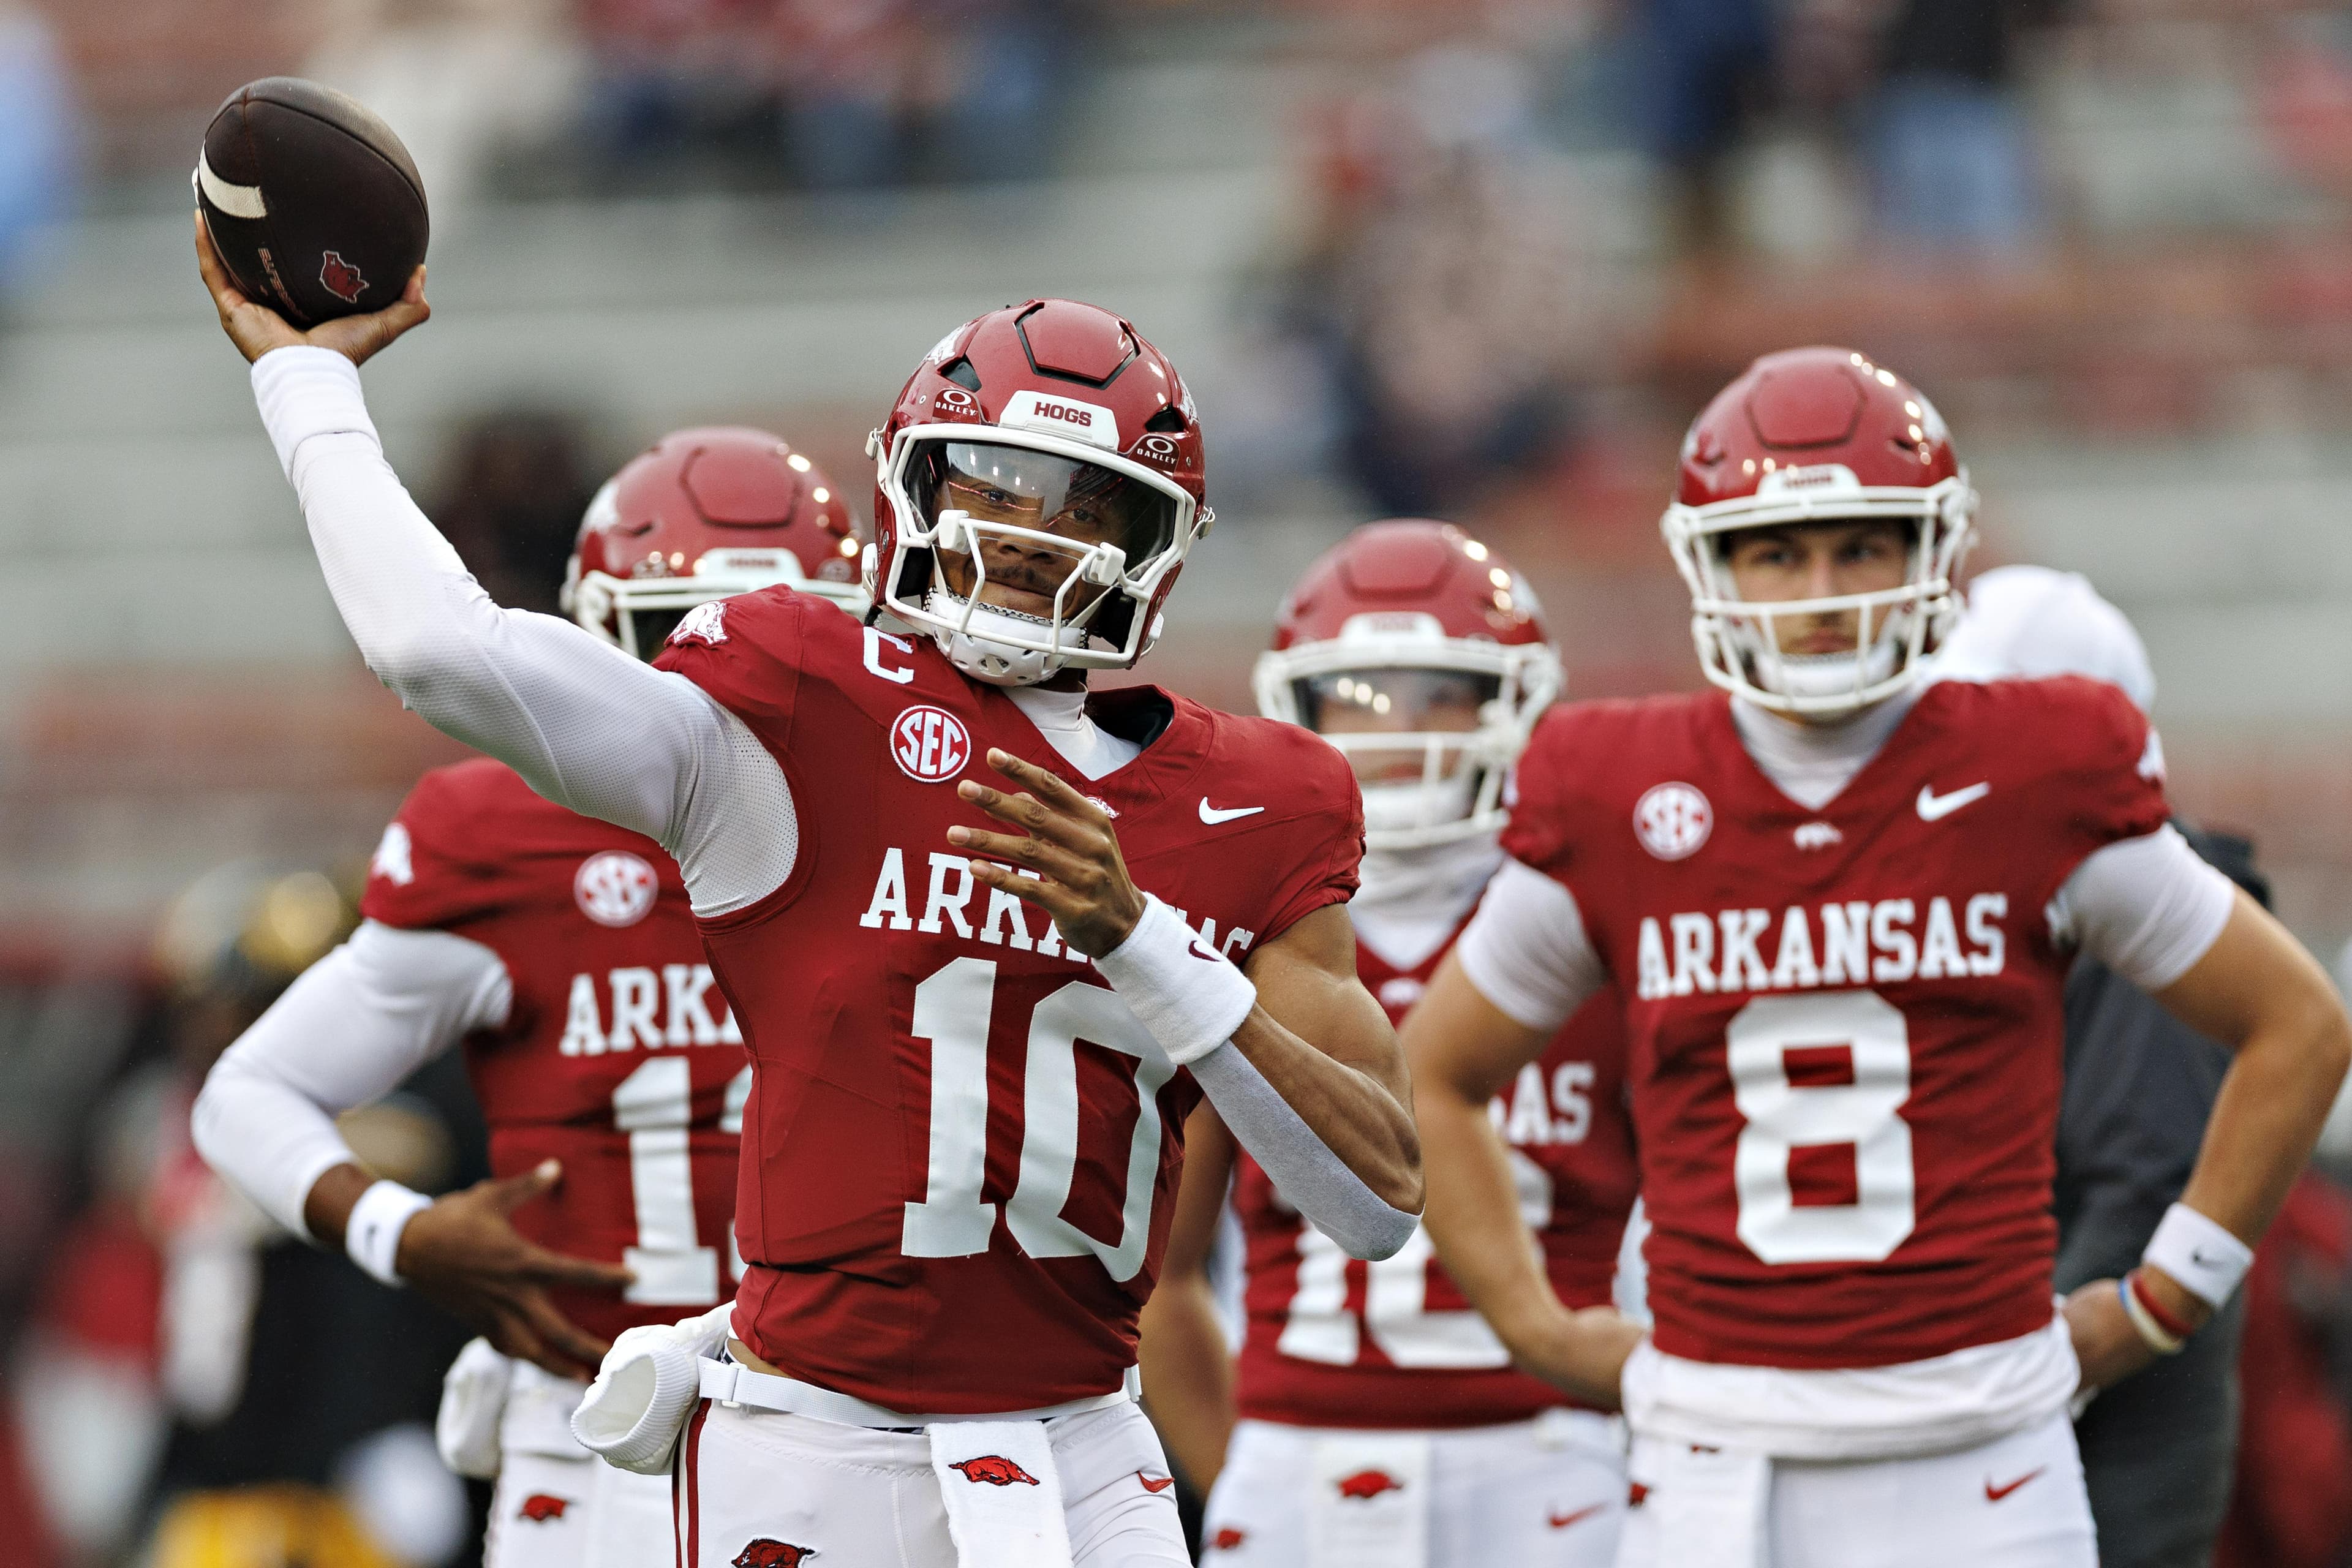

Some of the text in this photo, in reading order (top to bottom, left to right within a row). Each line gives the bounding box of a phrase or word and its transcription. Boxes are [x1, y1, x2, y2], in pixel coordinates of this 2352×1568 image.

[935, 401, 977, 417] OAKLEY
[1033, 401, 1092, 428] HOGS
[1137, 447, 1177, 465] OAKLEY
[863, 625, 914, 685] C
[899, 710, 963, 775] SEC
[1637, 892, 2008, 1001] ARKANSAS
[901, 956, 1177, 1282] 10
[1726, 988, 1915, 1266] 8
